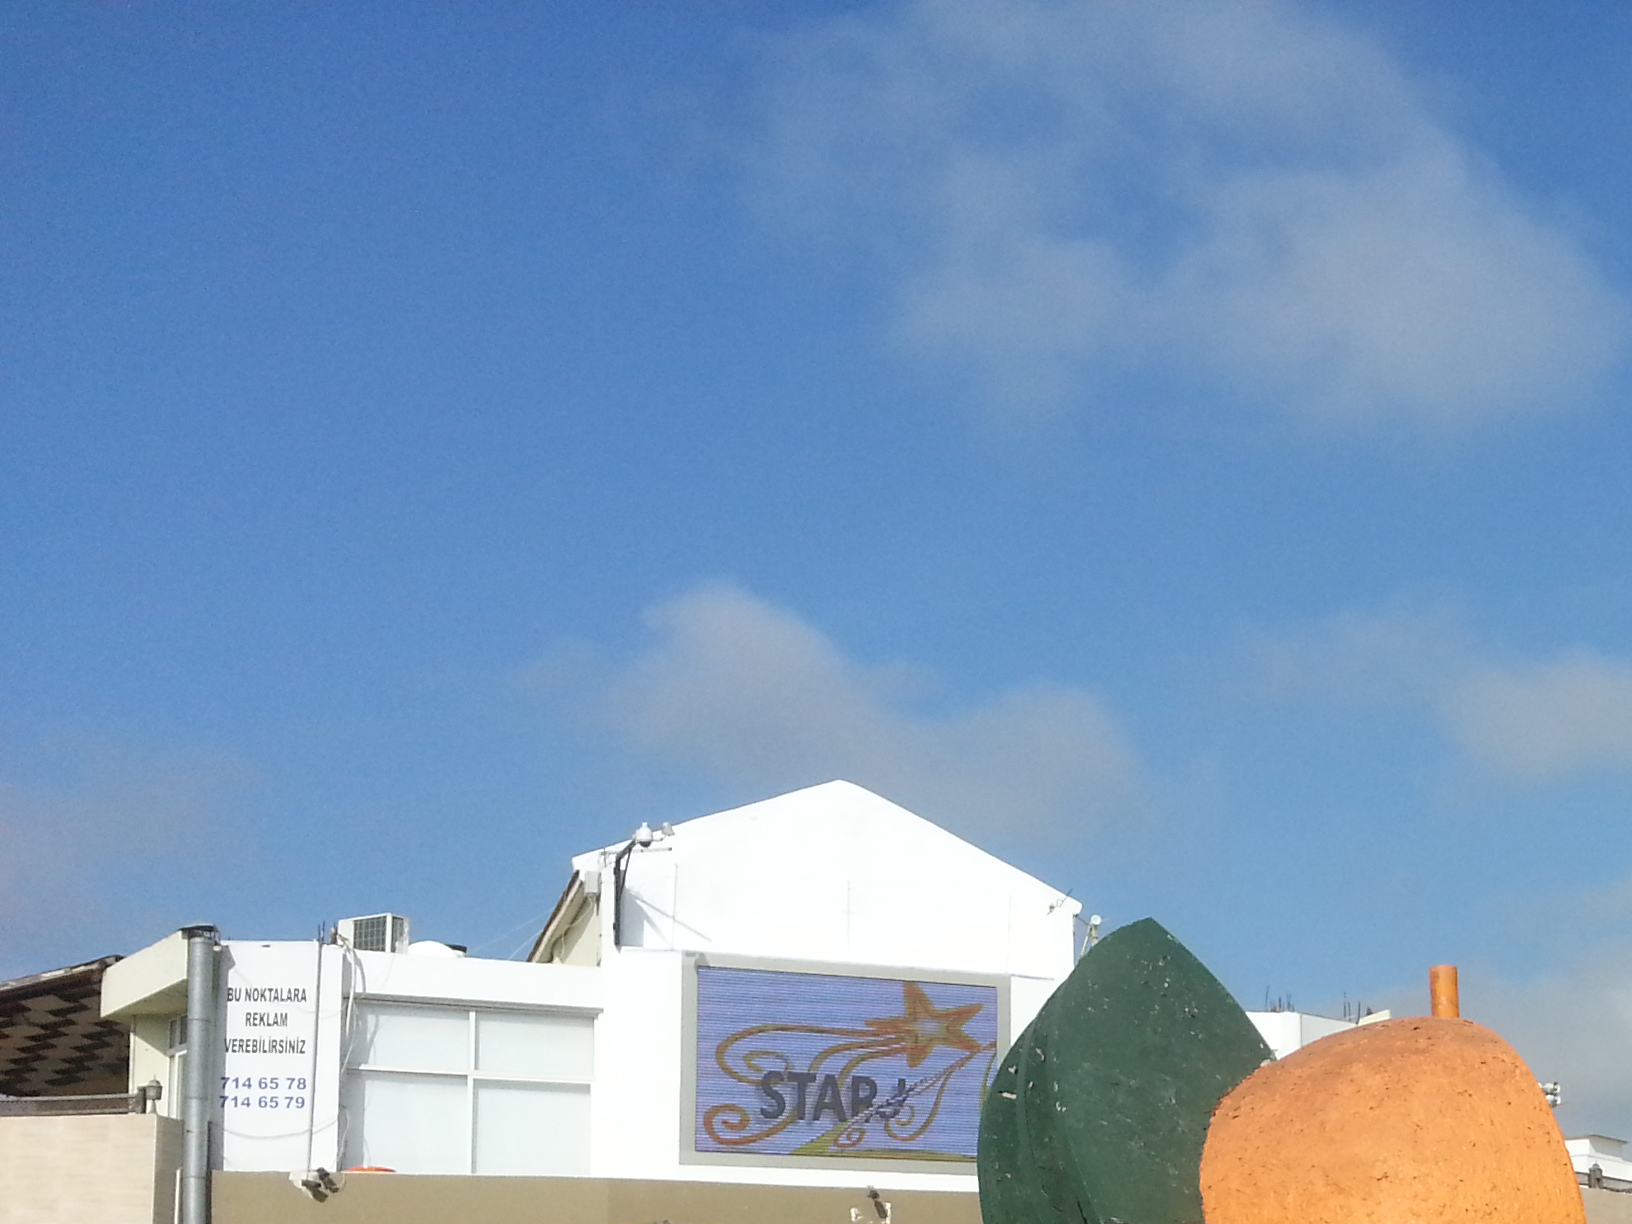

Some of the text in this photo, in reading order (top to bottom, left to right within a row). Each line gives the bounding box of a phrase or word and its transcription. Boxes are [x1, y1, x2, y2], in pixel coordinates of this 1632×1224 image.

[227, 987, 307, 1002] BU NOKTALARA
[245, 1011, 288, 1027] REKLAM
[223, 1036, 307, 1054] VEREBİLİRSİNİZ
[221, 1077, 307, 1090] 714 65 78
[219, 1095, 306, 1109] 714 65 79
